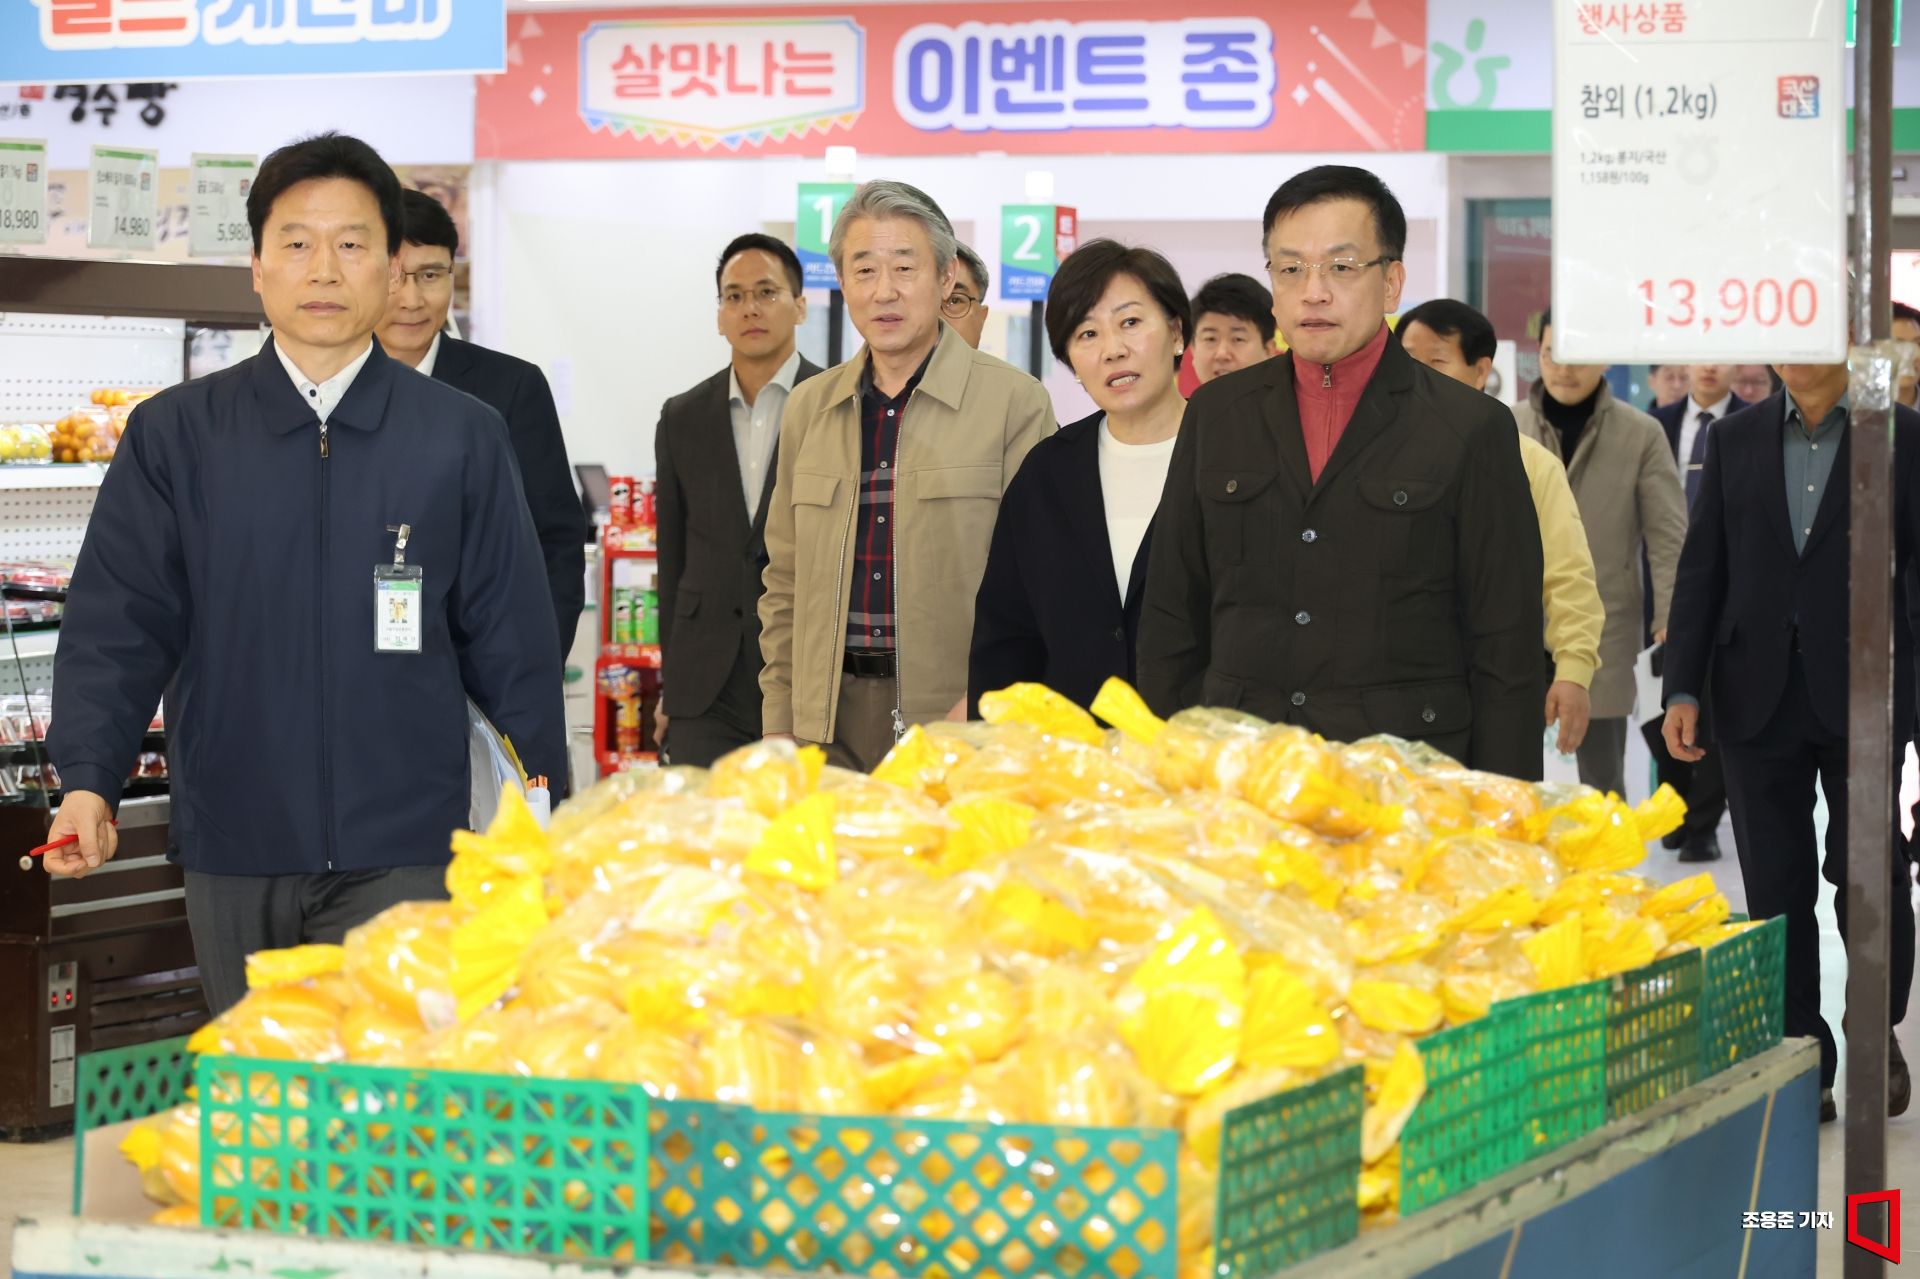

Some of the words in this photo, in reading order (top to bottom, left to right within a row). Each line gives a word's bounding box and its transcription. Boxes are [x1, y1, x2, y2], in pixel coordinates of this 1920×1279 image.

[1577, 2, 1687, 35] 행사상품
[611, 41, 835, 98] 살맛나는
[908, 33, 1149, 115] 이벤트
[1181, 32, 1260, 112] 존
[1580, 85, 1625, 119] 참외
[1634, 84, 1718, 119] (1.2kg)
[113, 215, 152, 238] 14,980
[813, 195, 834, 244] 1
[1012, 214, 1042, 260] 2
[1637, 278, 1818, 333] 13,900
